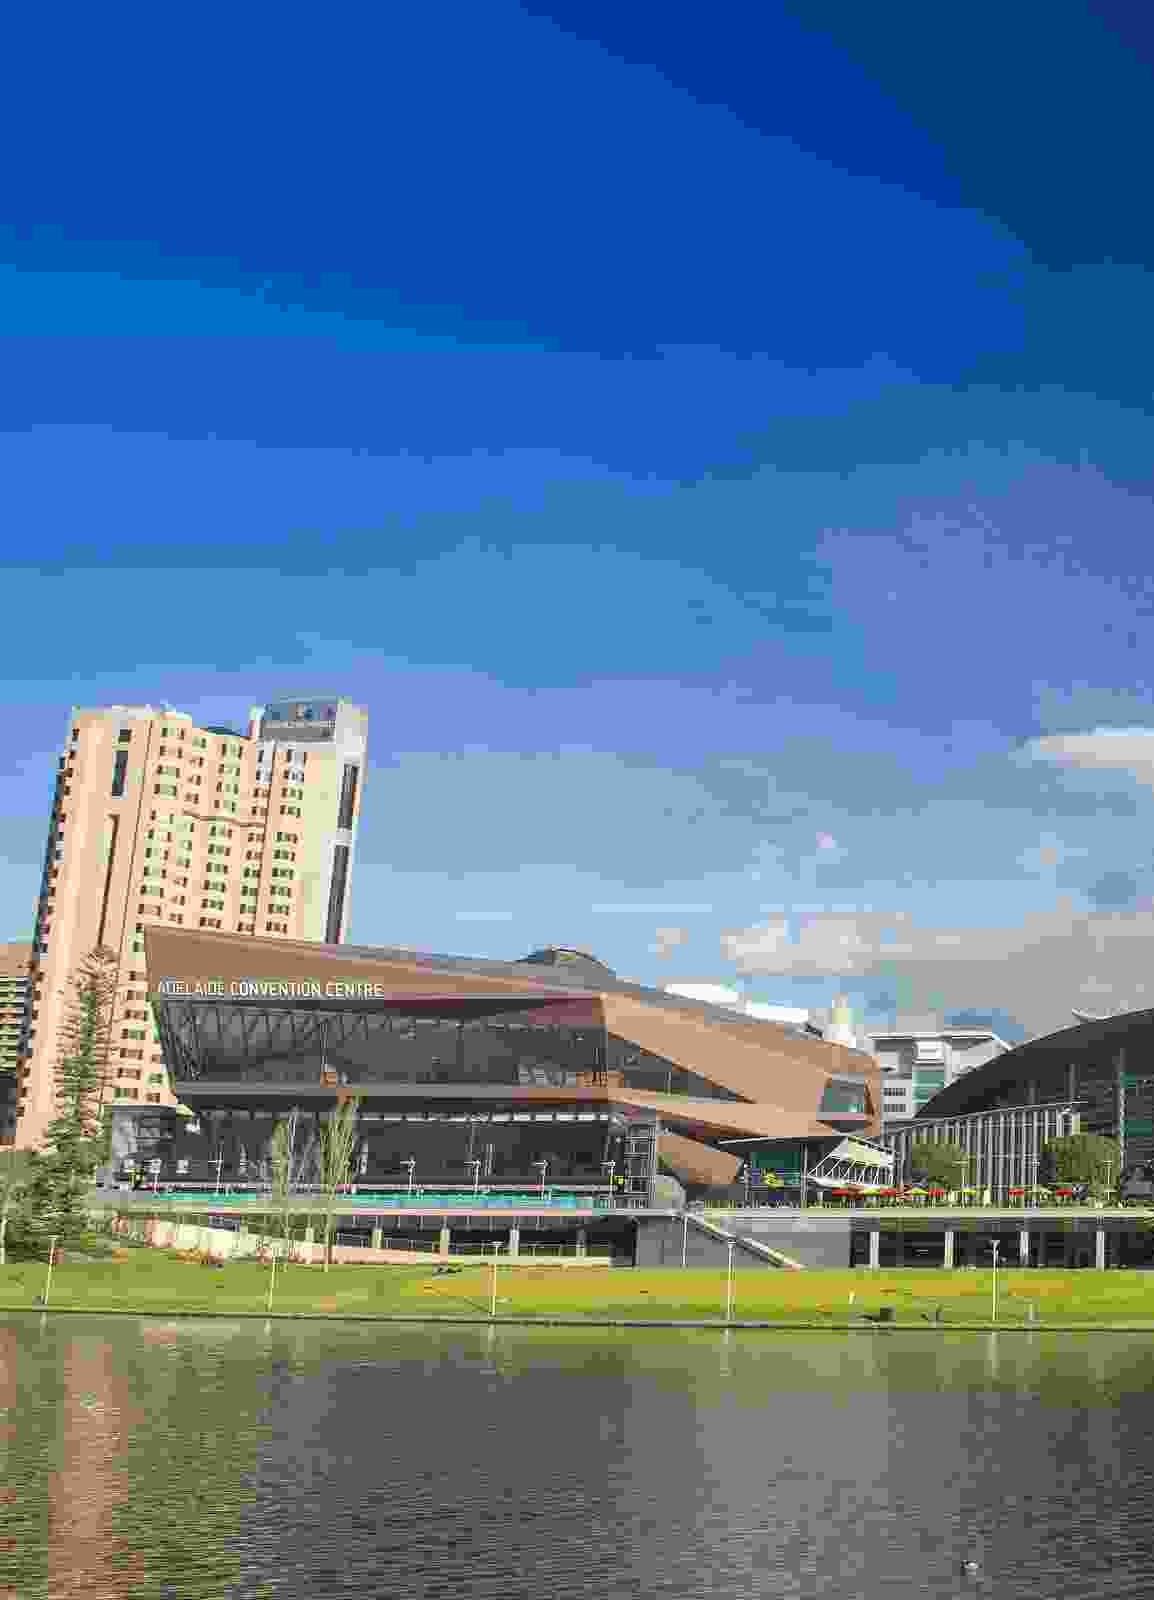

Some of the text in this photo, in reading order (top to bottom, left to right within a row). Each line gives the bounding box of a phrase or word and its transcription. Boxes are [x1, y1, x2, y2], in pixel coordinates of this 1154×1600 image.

[158, 981, 384, 999] ADELAIDE CONVENTION CENTRE
